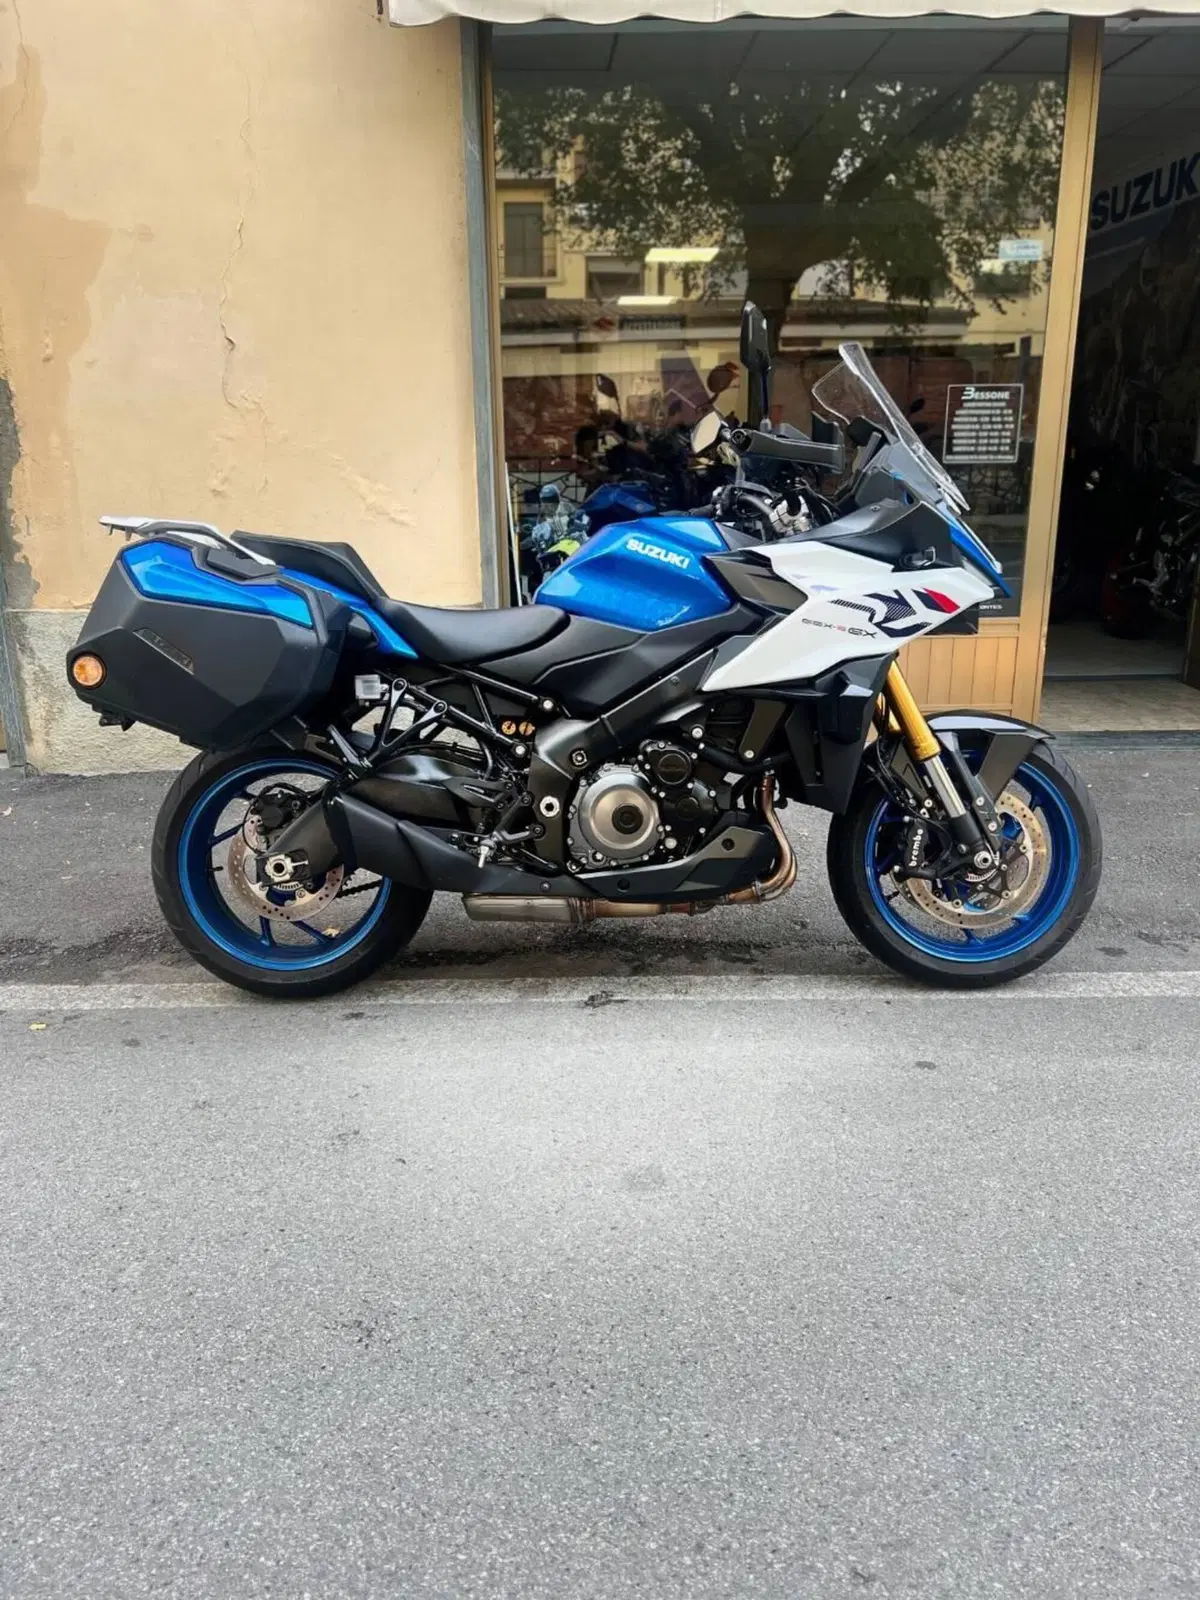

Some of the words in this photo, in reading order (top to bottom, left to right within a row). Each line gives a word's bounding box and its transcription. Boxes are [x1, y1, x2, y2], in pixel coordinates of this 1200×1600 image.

[961, 387, 1010, 400] BESSONE
[626, 538, 690, 569] SUZUKI
[908, 829, 924, 867] brembo
